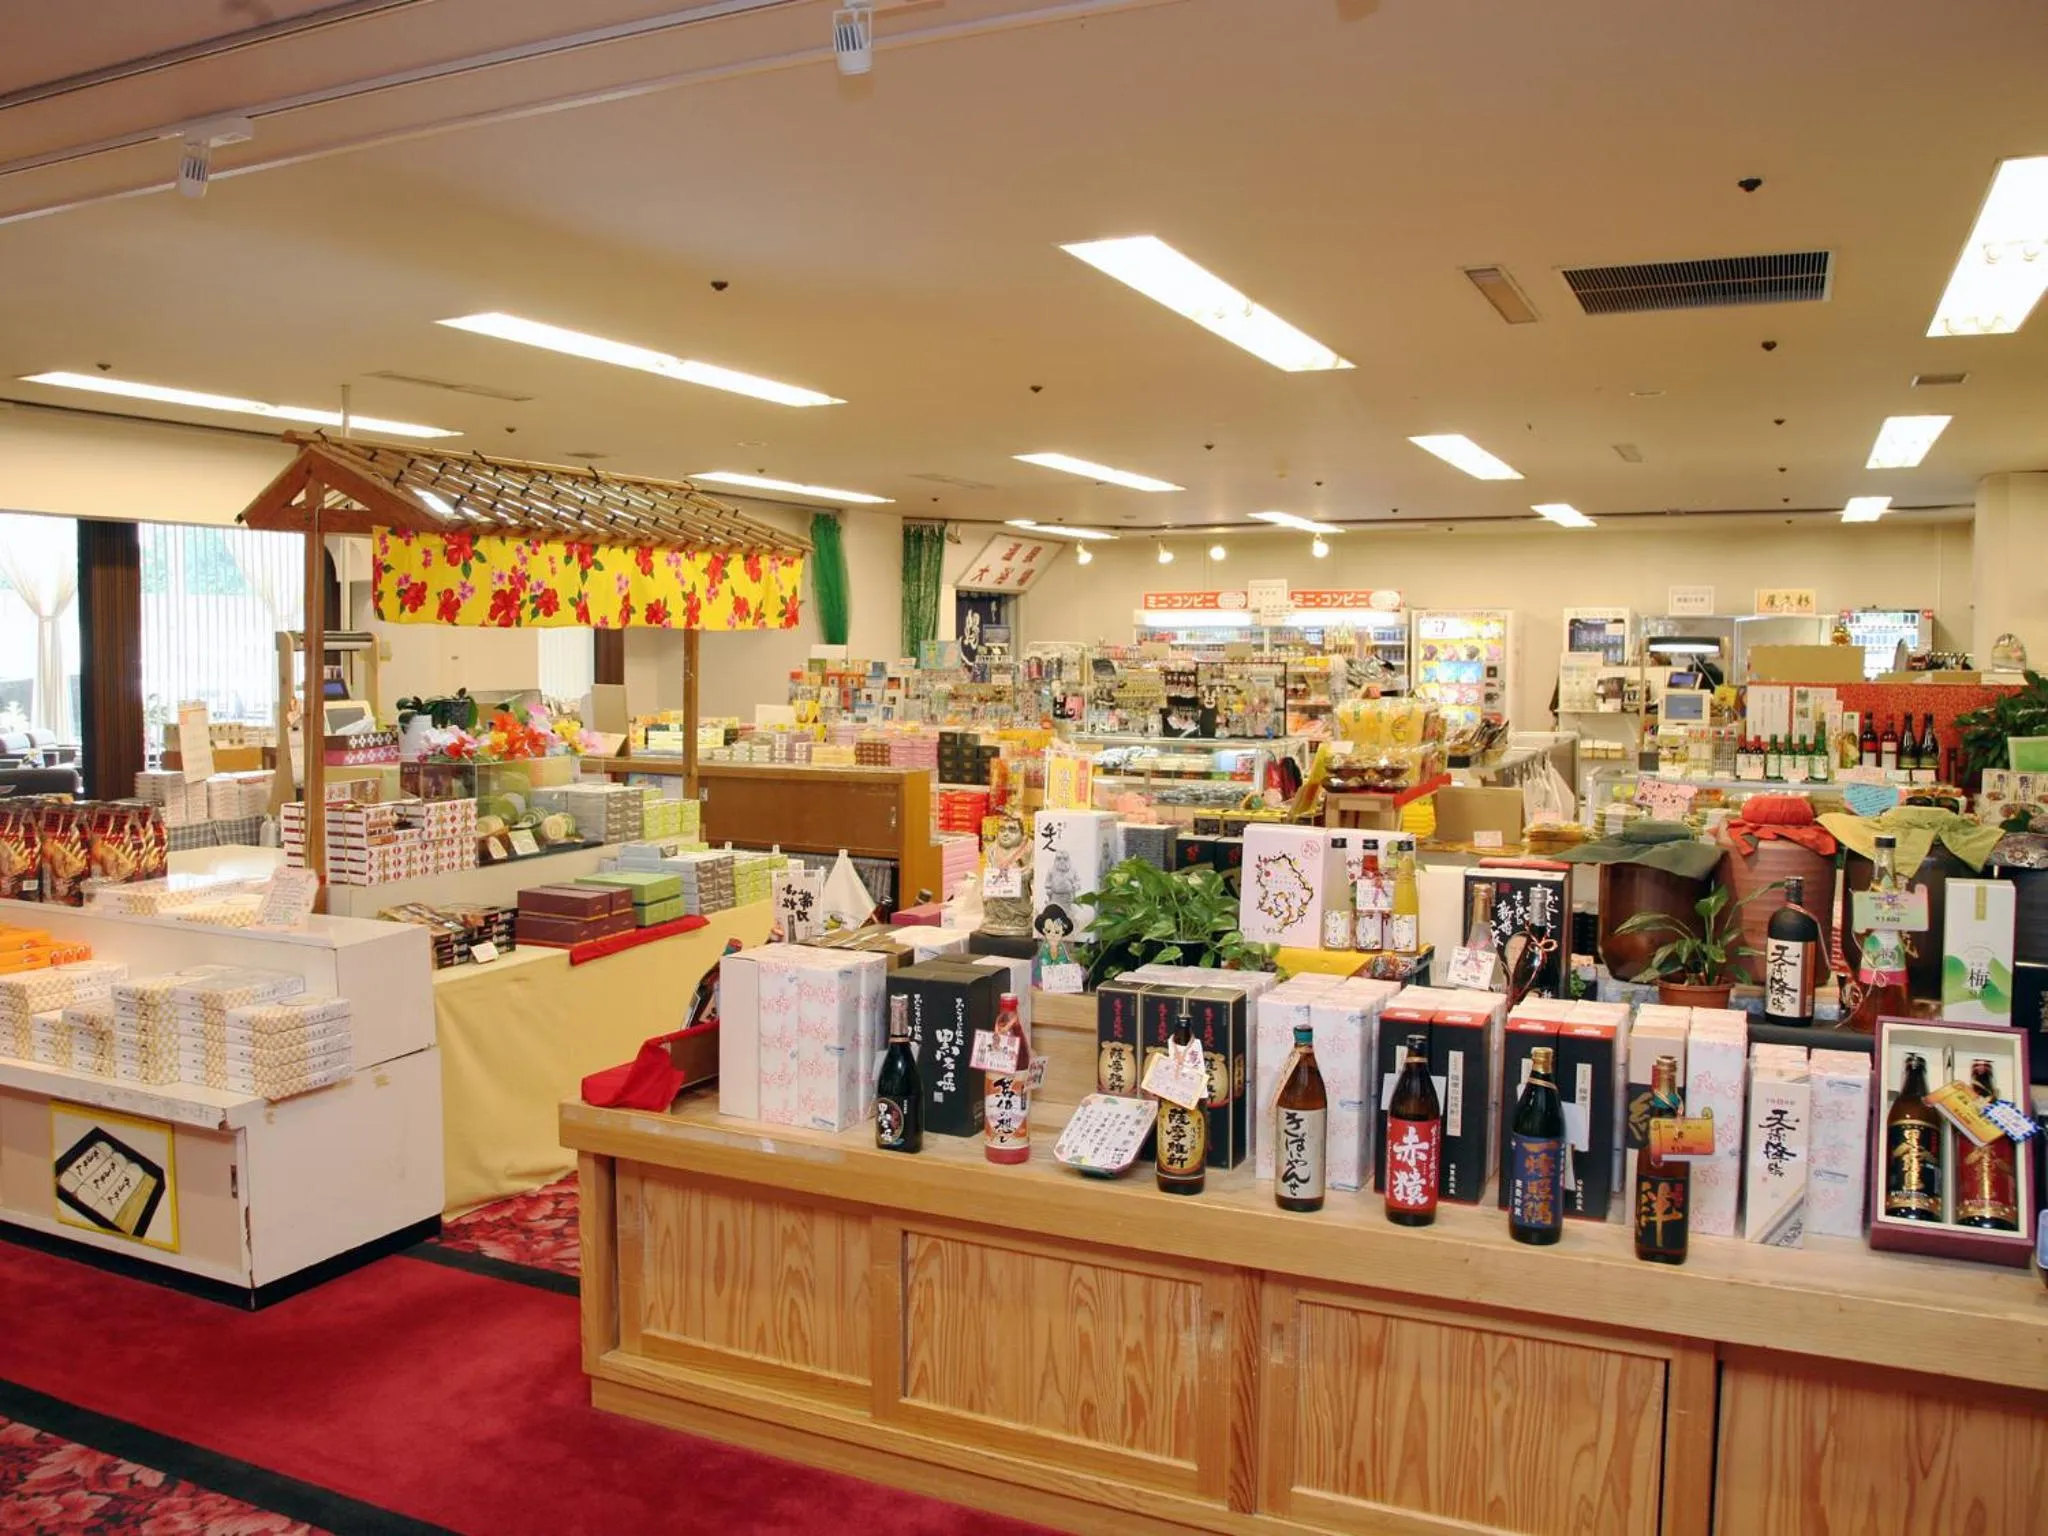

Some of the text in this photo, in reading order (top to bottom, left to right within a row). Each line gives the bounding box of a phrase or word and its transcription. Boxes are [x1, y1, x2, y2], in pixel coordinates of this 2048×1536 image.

[1147, 595, 1216, 608] ミニ・コンビニ
[1293, 594, 1368, 607] ミニ・コンビニ
[1968, 968, 1990, 990] 梅
[1165, 1107, 1190, 1169] 薩摩維新
[1392, 1126, 1430, 1206] 赤猿
